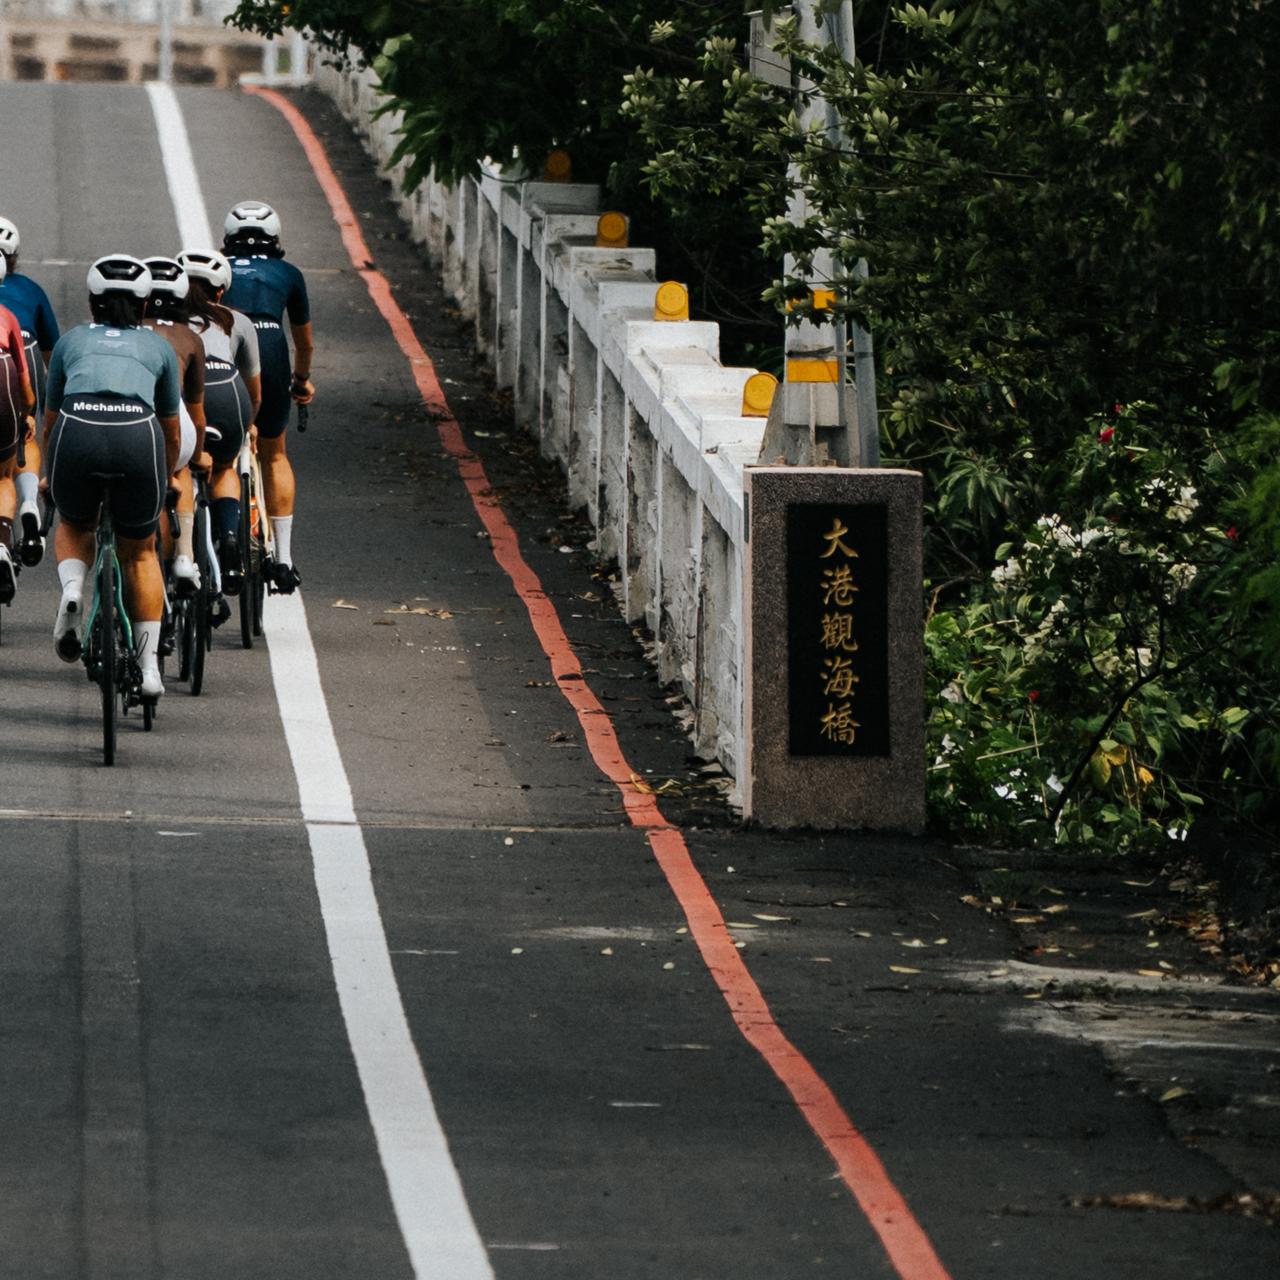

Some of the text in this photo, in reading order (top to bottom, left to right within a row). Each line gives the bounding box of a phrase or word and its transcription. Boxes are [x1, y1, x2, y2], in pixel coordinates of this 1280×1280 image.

[73, 401, 144, 414] Mechanism
[820, 518, 860, 745] 大港觀海橋
